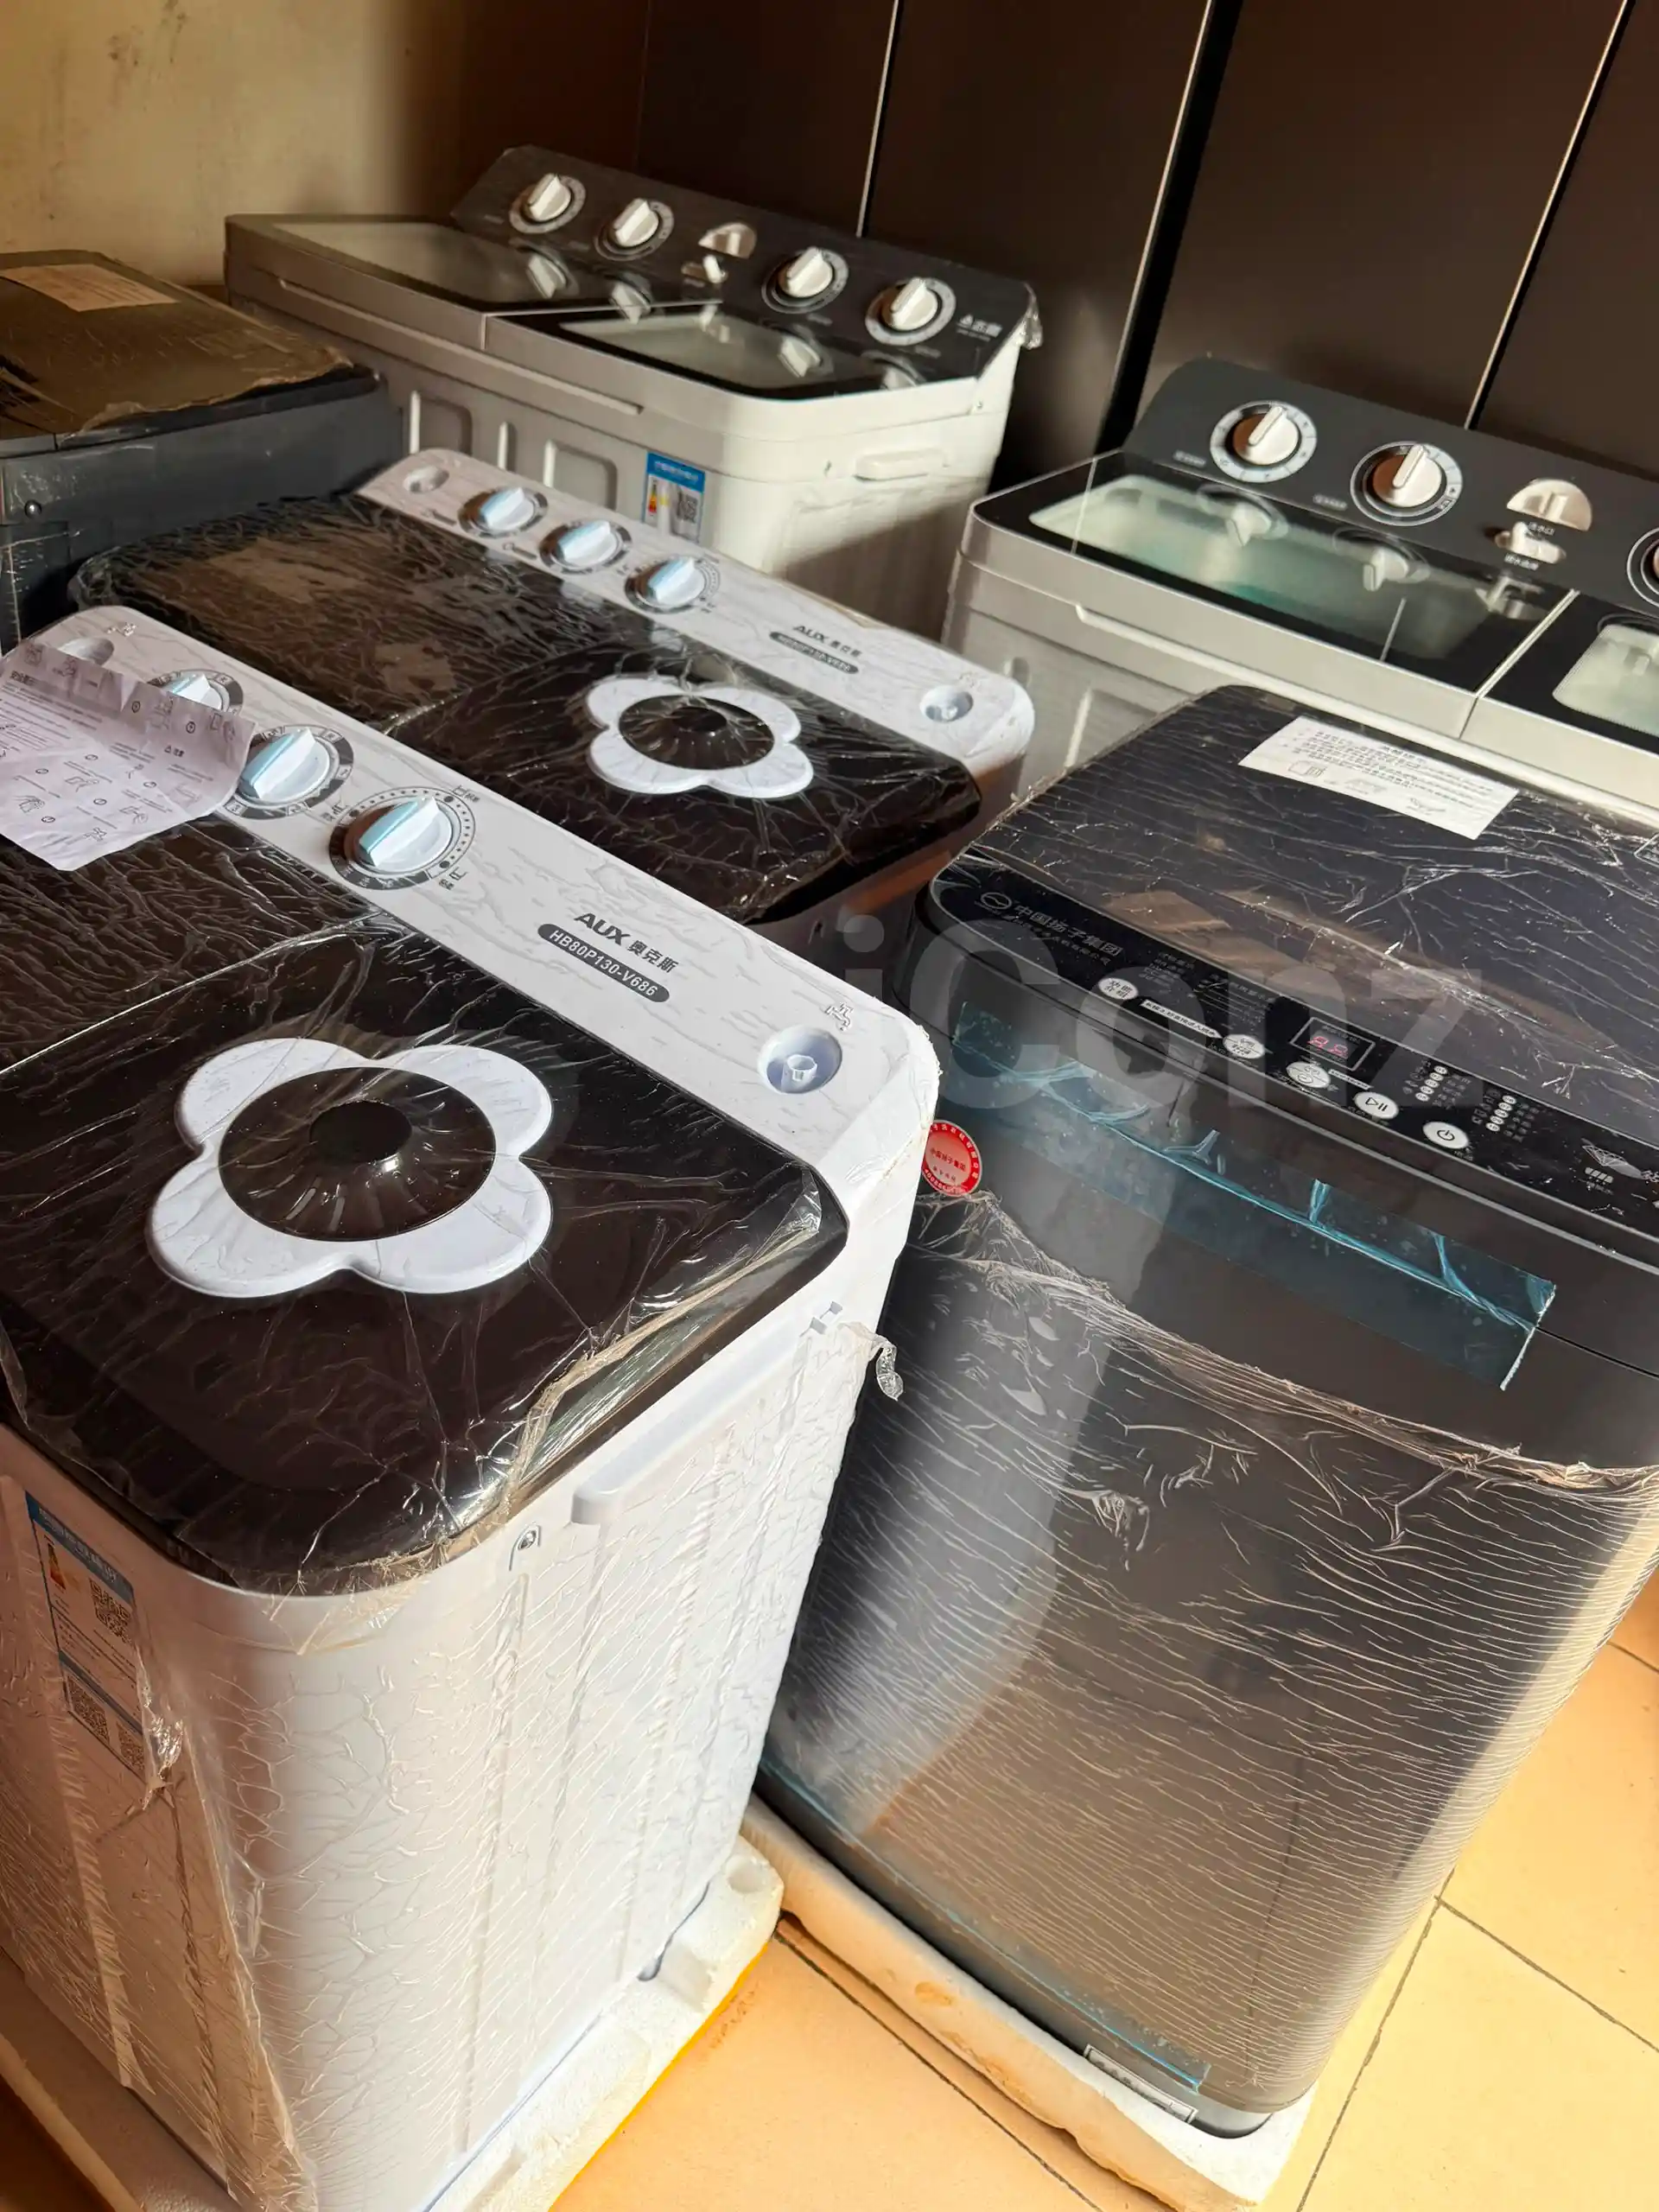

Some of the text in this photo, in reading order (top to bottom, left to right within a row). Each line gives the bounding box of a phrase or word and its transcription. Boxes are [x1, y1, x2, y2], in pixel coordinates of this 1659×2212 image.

[792, 626, 830, 643] AUX
[550, 930, 658, 995] HB80P130-V686
[574, 912, 679, 973] AUX 奥克斯
